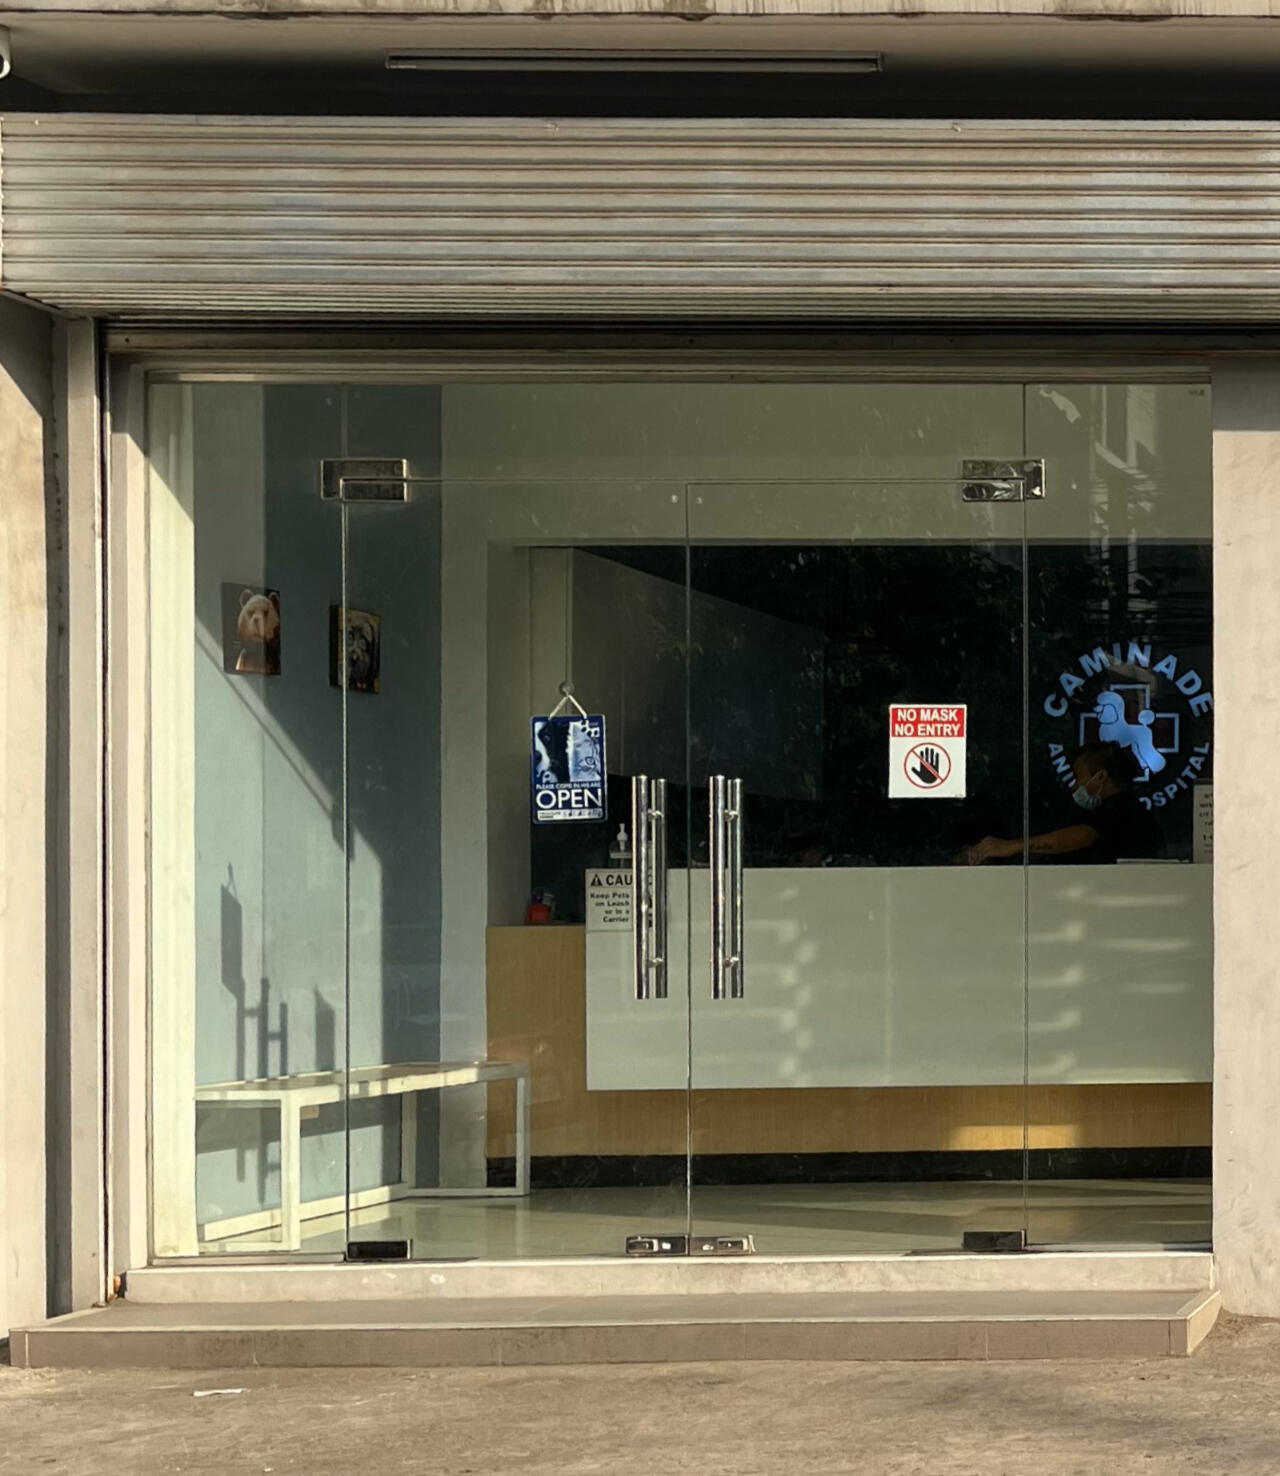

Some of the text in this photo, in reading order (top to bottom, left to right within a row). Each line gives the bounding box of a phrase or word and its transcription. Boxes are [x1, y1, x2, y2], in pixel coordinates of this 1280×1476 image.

[1044, 641, 1212, 718] CAMINADE
[897, 709, 958, 721] NO MASK
[894, 724, 960, 736] NO ENTRY
[536, 789, 602, 809] OPEN
